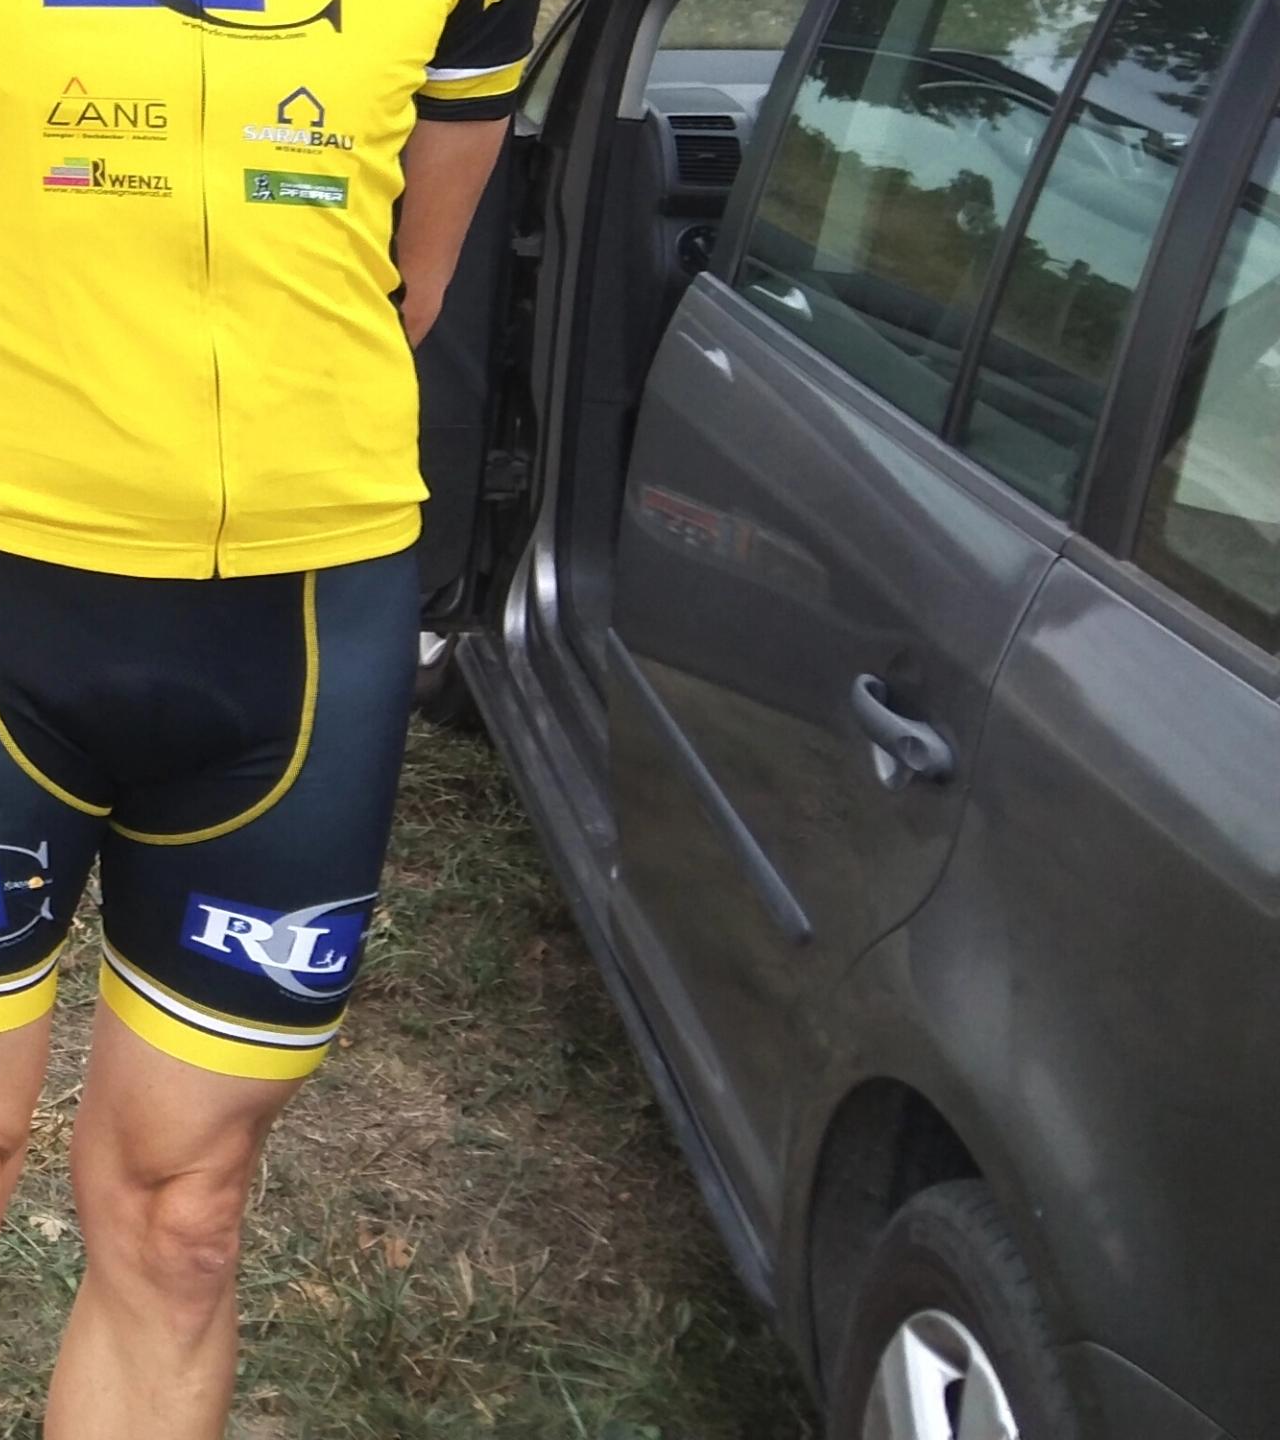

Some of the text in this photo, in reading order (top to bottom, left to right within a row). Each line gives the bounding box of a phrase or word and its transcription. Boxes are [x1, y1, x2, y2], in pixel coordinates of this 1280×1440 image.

[46, 101, 168, 128] LANG
[243, 124, 355, 151] SARABAU
[108, 174, 173, 191] WENZL
